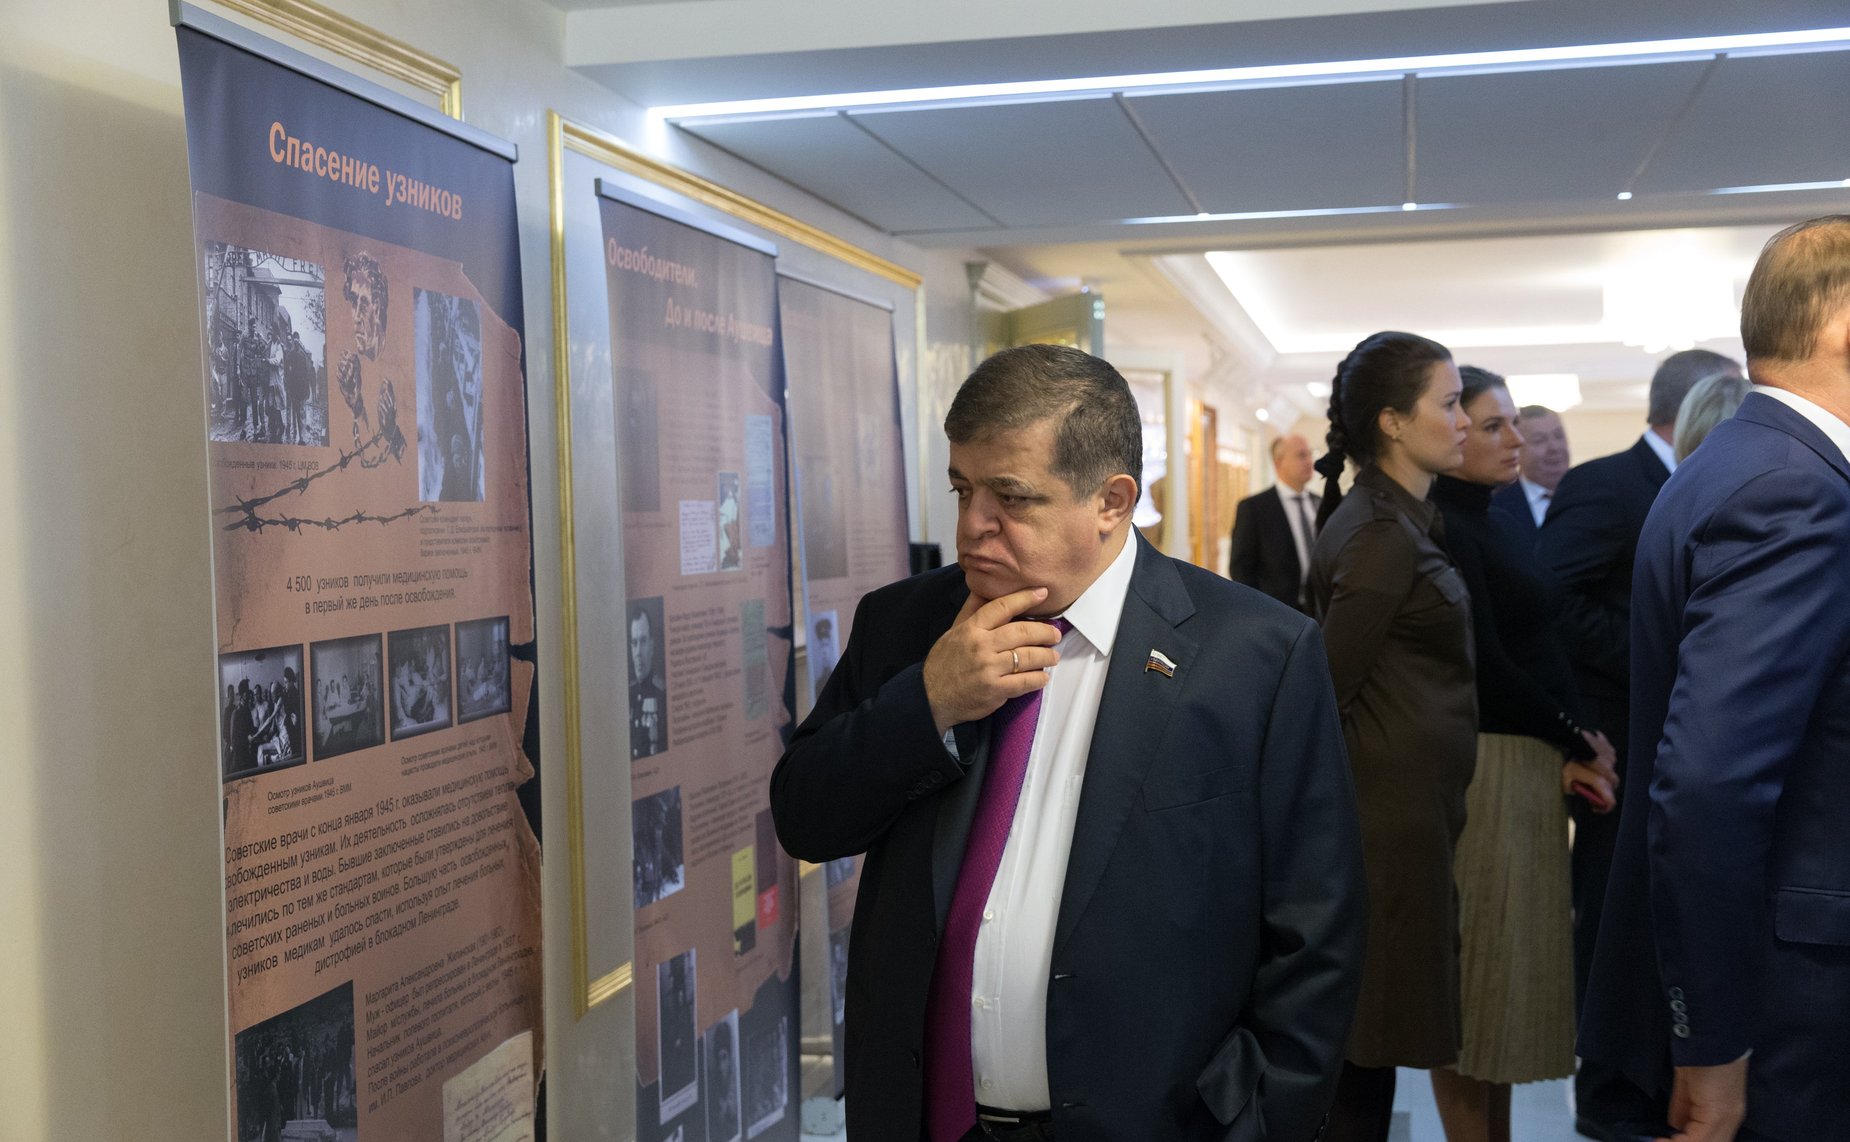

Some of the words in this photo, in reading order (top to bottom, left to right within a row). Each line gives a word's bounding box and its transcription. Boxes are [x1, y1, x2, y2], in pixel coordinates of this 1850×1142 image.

[269, 121, 380, 193] Спасение
[385, 170, 462, 220] узников
[608, 237, 698, 289] Освободители.
[664, 297, 682, 328] До
[684, 307, 692, 328] и
[694, 310, 726, 335] после
[286, 577, 292, 592] 4
[295, 575, 312, 591] 500
[316, 576, 349, 594] узников
[353, 571, 390, 590] получили
[392, 568, 441, 586] медицинскую
[305, 601, 310, 614] в
[313, 595, 344, 616] первый
[345, 597, 358, 610] же
[359, 593, 379, 610] день
[380, 592, 403, 606] после
[267, 787, 290, 802] Осмотр
[280, 827, 308, 851] врачи
[310, 825, 316, 838] с
[318, 817, 342, 834] конца
[344, 806, 373, 826] января
[376, 797, 394, 817] 1945
[396, 797, 401, 808] г.
[402, 786, 441, 808] оказывали
[442, 771, 484, 795] медицинскую
[300, 842, 338, 868] узникам.
[340, 834, 352, 848] Их
[353, 819, 407, 847] деятельность
[410, 802, 456, 826] осложнялась
[457, 788, 494, 810] отсутствием
[228, 876, 302, 913] электричества
[304, 876, 310, 886] и
[312, 865, 336, 884] воды.
[338, 851, 372, 873] Бывшие
[374, 832, 425, 861] заключенные
[426, 819, 461, 841] ставились
[231, 908, 280, 937] лечились
[282, 901, 295, 918] по
[297, 895, 314, 912] тем
[315, 890, 328, 904] же
[329, 870, 379, 899] стандартам,
[381, 855, 414, 879] которые
[414, 850, 434, 866] были
[435, 834, 479, 862] утверждены
[232, 928, 283, 960] советских
[285, 913, 326, 943] раненых
[327, 910, 333, 922] и
[334, 893, 370, 919] больных
[371, 882, 401, 904] воинов.
[403, 866, 439, 892] Большую
[439, 859, 458, 876] часть
[236, 955, 278, 986] узников
[284, 936, 325, 964] медикам
[328, 921, 364, 949] удалось
[365, 907, 394, 927] спасти,
[395, 887, 434, 915] используя
[434, 880, 452, 900] опыт
[452, 868, 479, 891] лечения
[314, 935, 367, 976] дистрофией
[369, 936, 374, 948] в
[375, 916, 417, 945] блокадном
